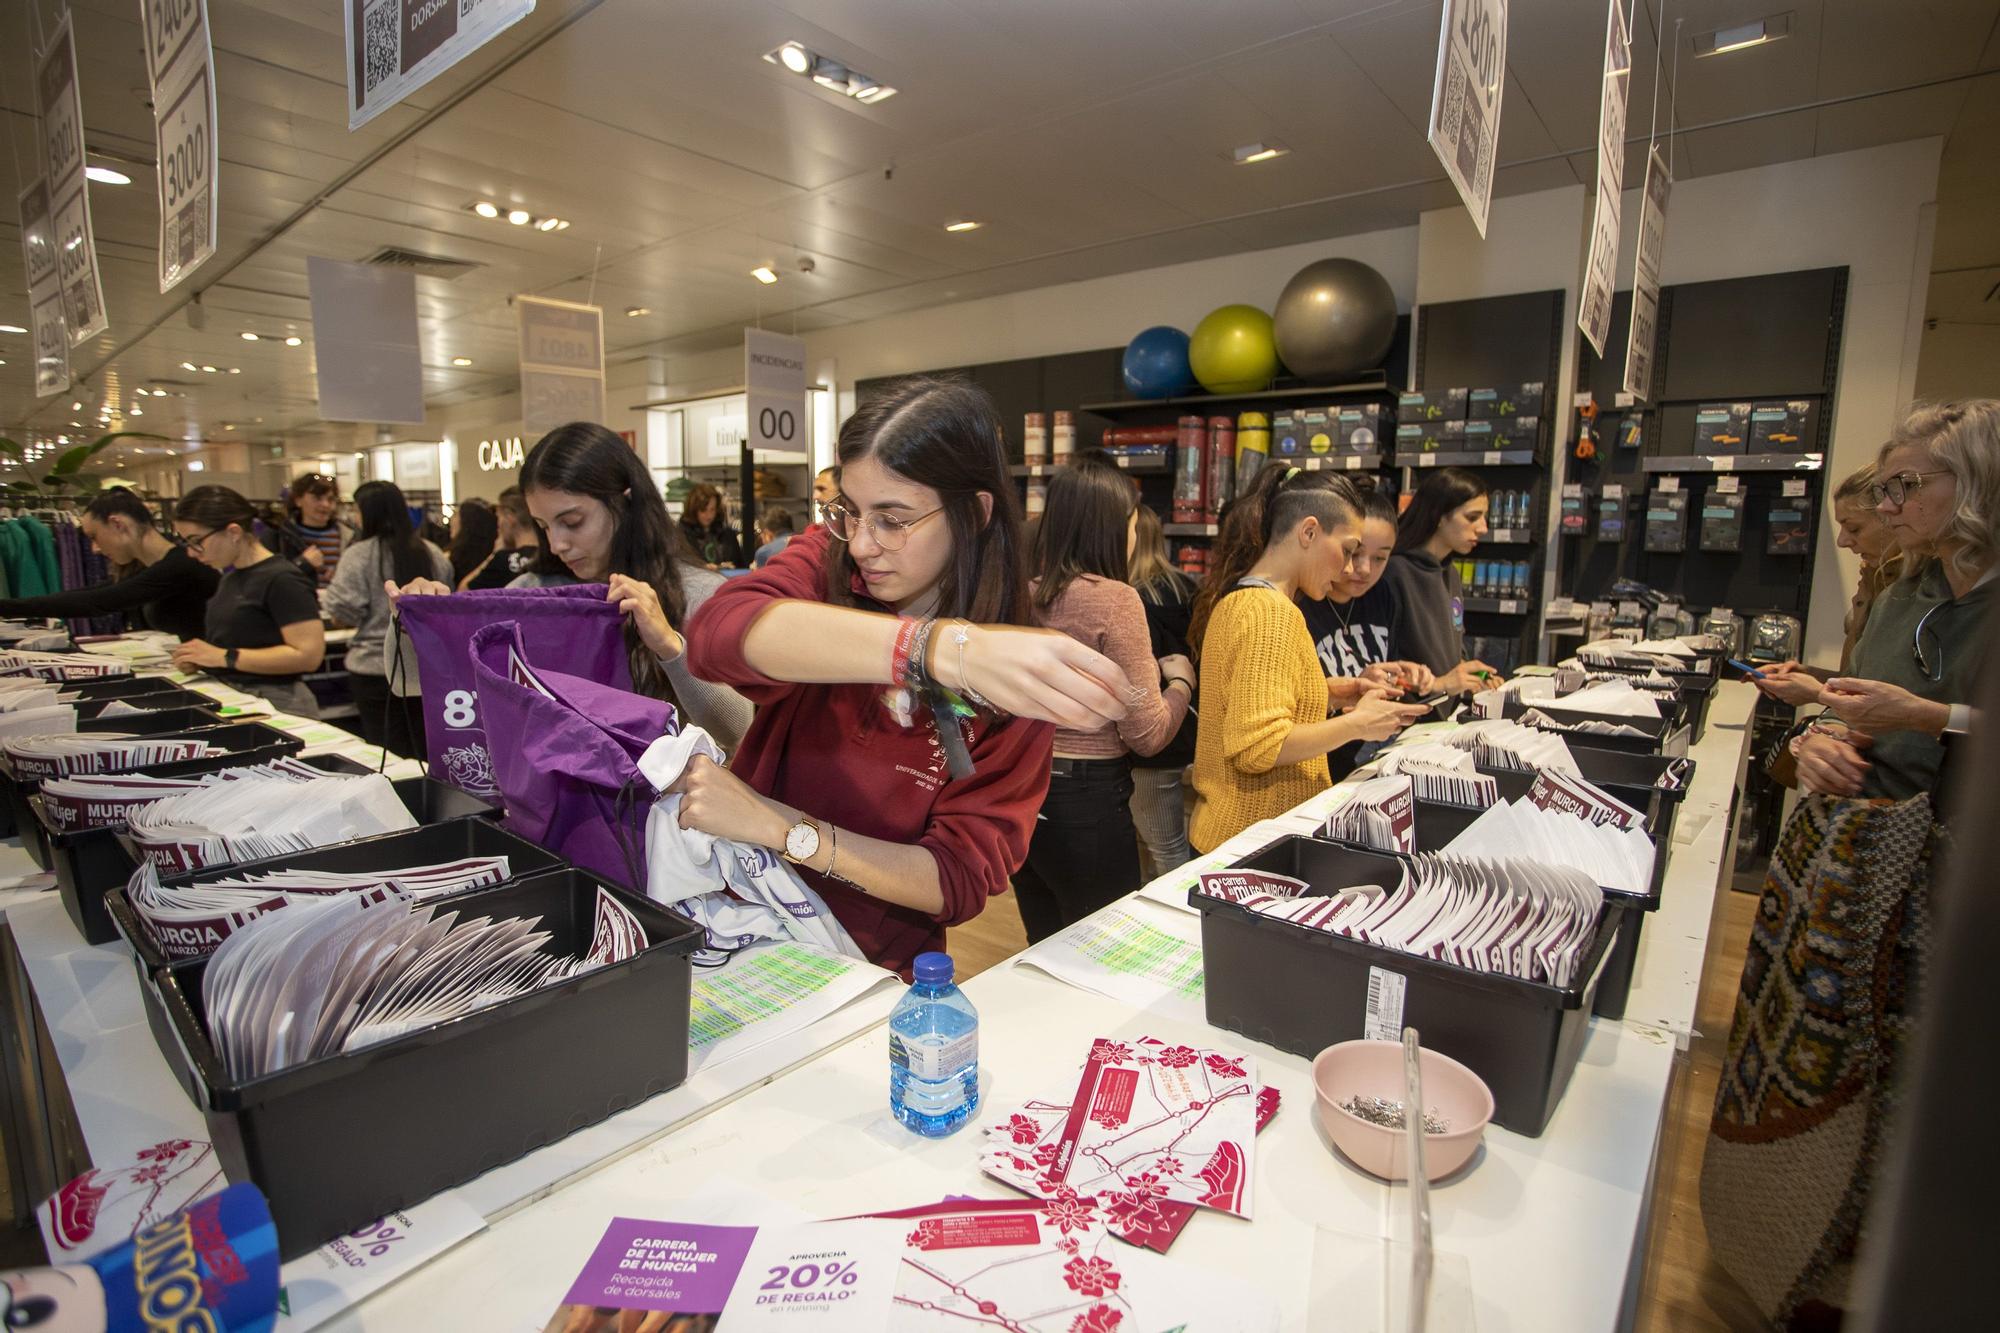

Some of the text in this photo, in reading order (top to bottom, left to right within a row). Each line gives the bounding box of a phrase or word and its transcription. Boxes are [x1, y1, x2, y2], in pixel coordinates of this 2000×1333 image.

[167, 123, 204, 206] 3000
[760, 407, 795, 442] 00
[478, 437, 525, 471] CAJA
[16, 759, 54, 774] MURCIA
[1551, 789, 1585, 819] MURCIA
[155, 926, 224, 946] URCIA
[632, 1238, 697, 1250] CARRERA
[329, 1240, 366, 1267] EGALO
[626, 1248, 717, 1263] DE LA MUJER
[789, 1251, 847, 1261] APROVECHA
[619, 1259, 697, 1273] DE MURCIA
[611, 1273, 674, 1287] Recogida
[760, 1260, 858, 1290] 20%
[604, 1285, 681, 1299] de dorsales
[755, 1294, 779, 1304] DE
